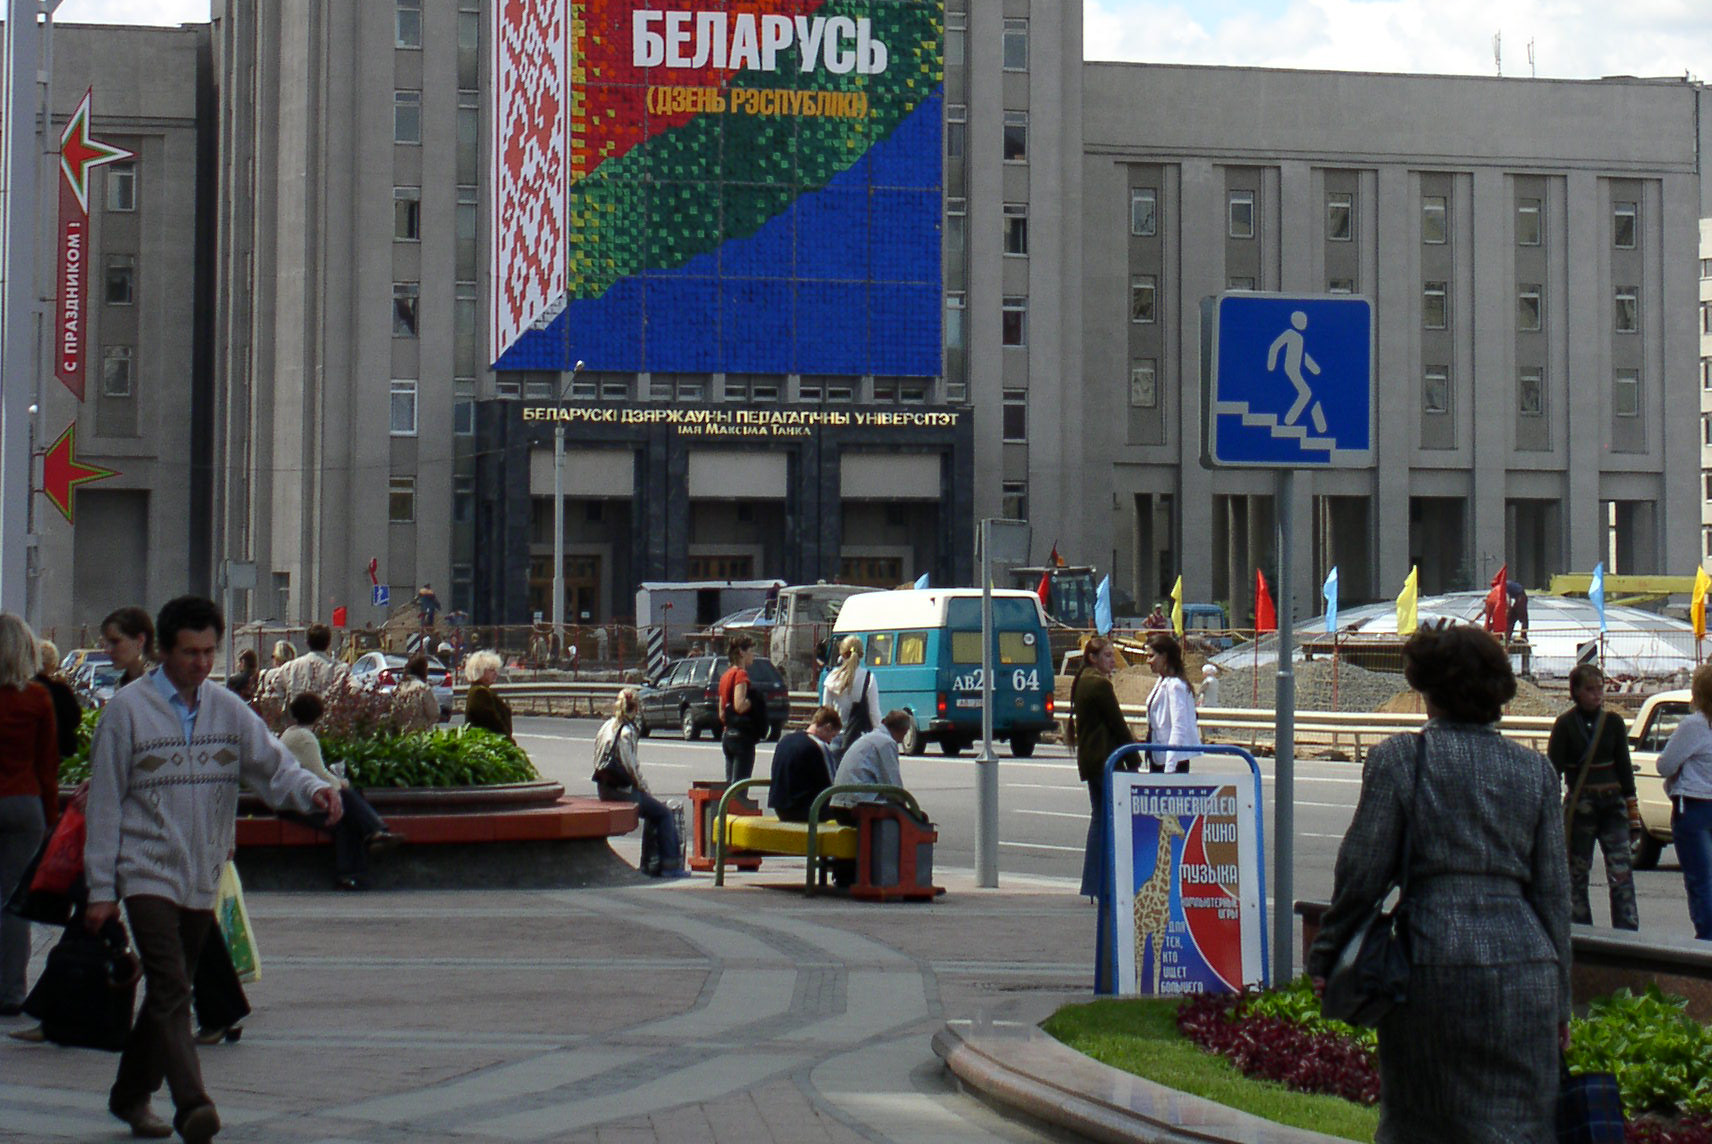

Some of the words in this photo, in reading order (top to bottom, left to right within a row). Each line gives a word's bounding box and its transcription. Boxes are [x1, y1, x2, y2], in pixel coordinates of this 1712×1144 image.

[633, 9, 889, 75] БЕЛАРУСЬ
[646, 86, 727, 114] (ДЗЕНЬ
[730, 87, 869, 119] РЭСПУБЛІКІ)
[64, 361, 77, 372] С
[523, 407, 617, 422] БЕЛАРУСКІ
[736, 410, 850, 425] ПЕДАГАГІЧНЫ
[854, 412, 960, 426] УНІВЕРСІТЭТ
[1012, 669, 1040, 691] 64
[1204, 823, 1237, 843] КИНО
[1179, 864, 1238, 884] МУЗЫКА
[1162, 951, 1178, 963] КТО
